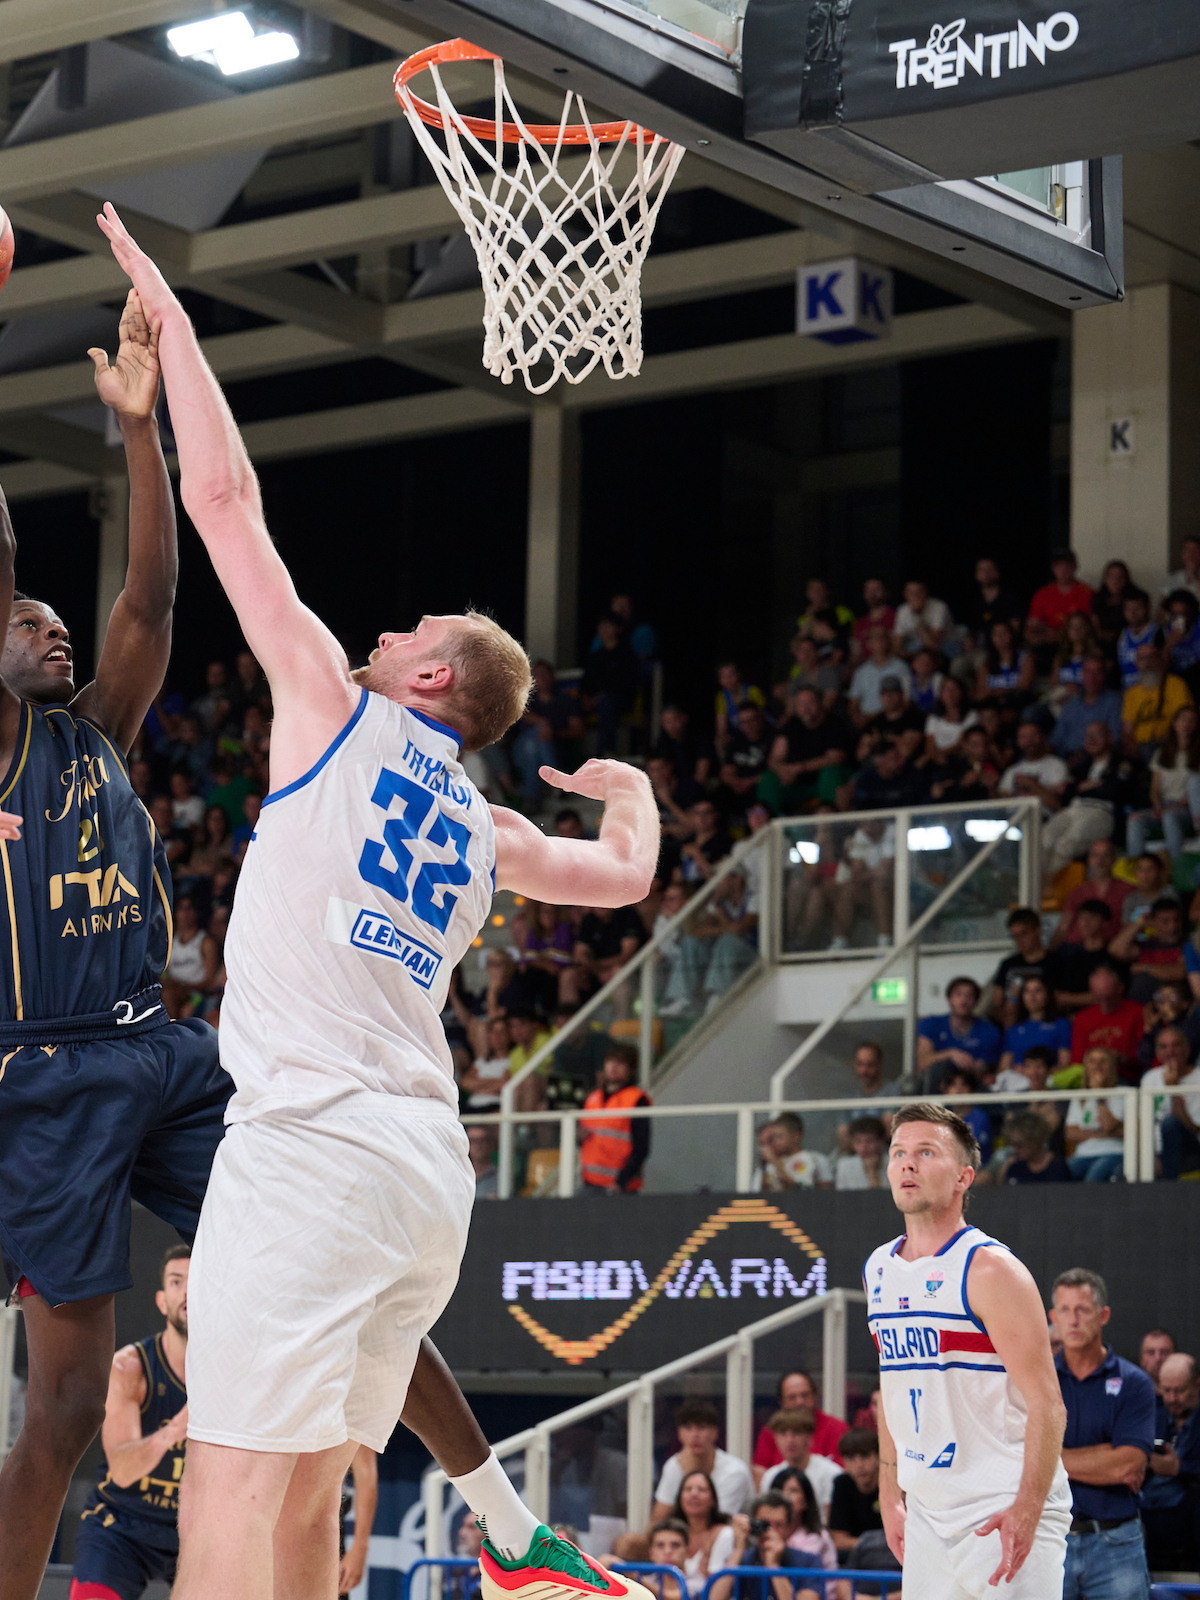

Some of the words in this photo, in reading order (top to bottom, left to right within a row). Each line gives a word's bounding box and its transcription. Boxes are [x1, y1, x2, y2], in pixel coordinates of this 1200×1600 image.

[888, 11, 1080, 90] TRENTINO
[805, 271, 844, 321] K
[860, 272, 885, 323] K
[1110, 420, 1131, 451] K
[358, 766, 473, 936] 32
[48, 862, 140, 911] ITA
[501, 1257, 828, 1300] FISIOWARM
[140, 1476, 181, 1497] IT
